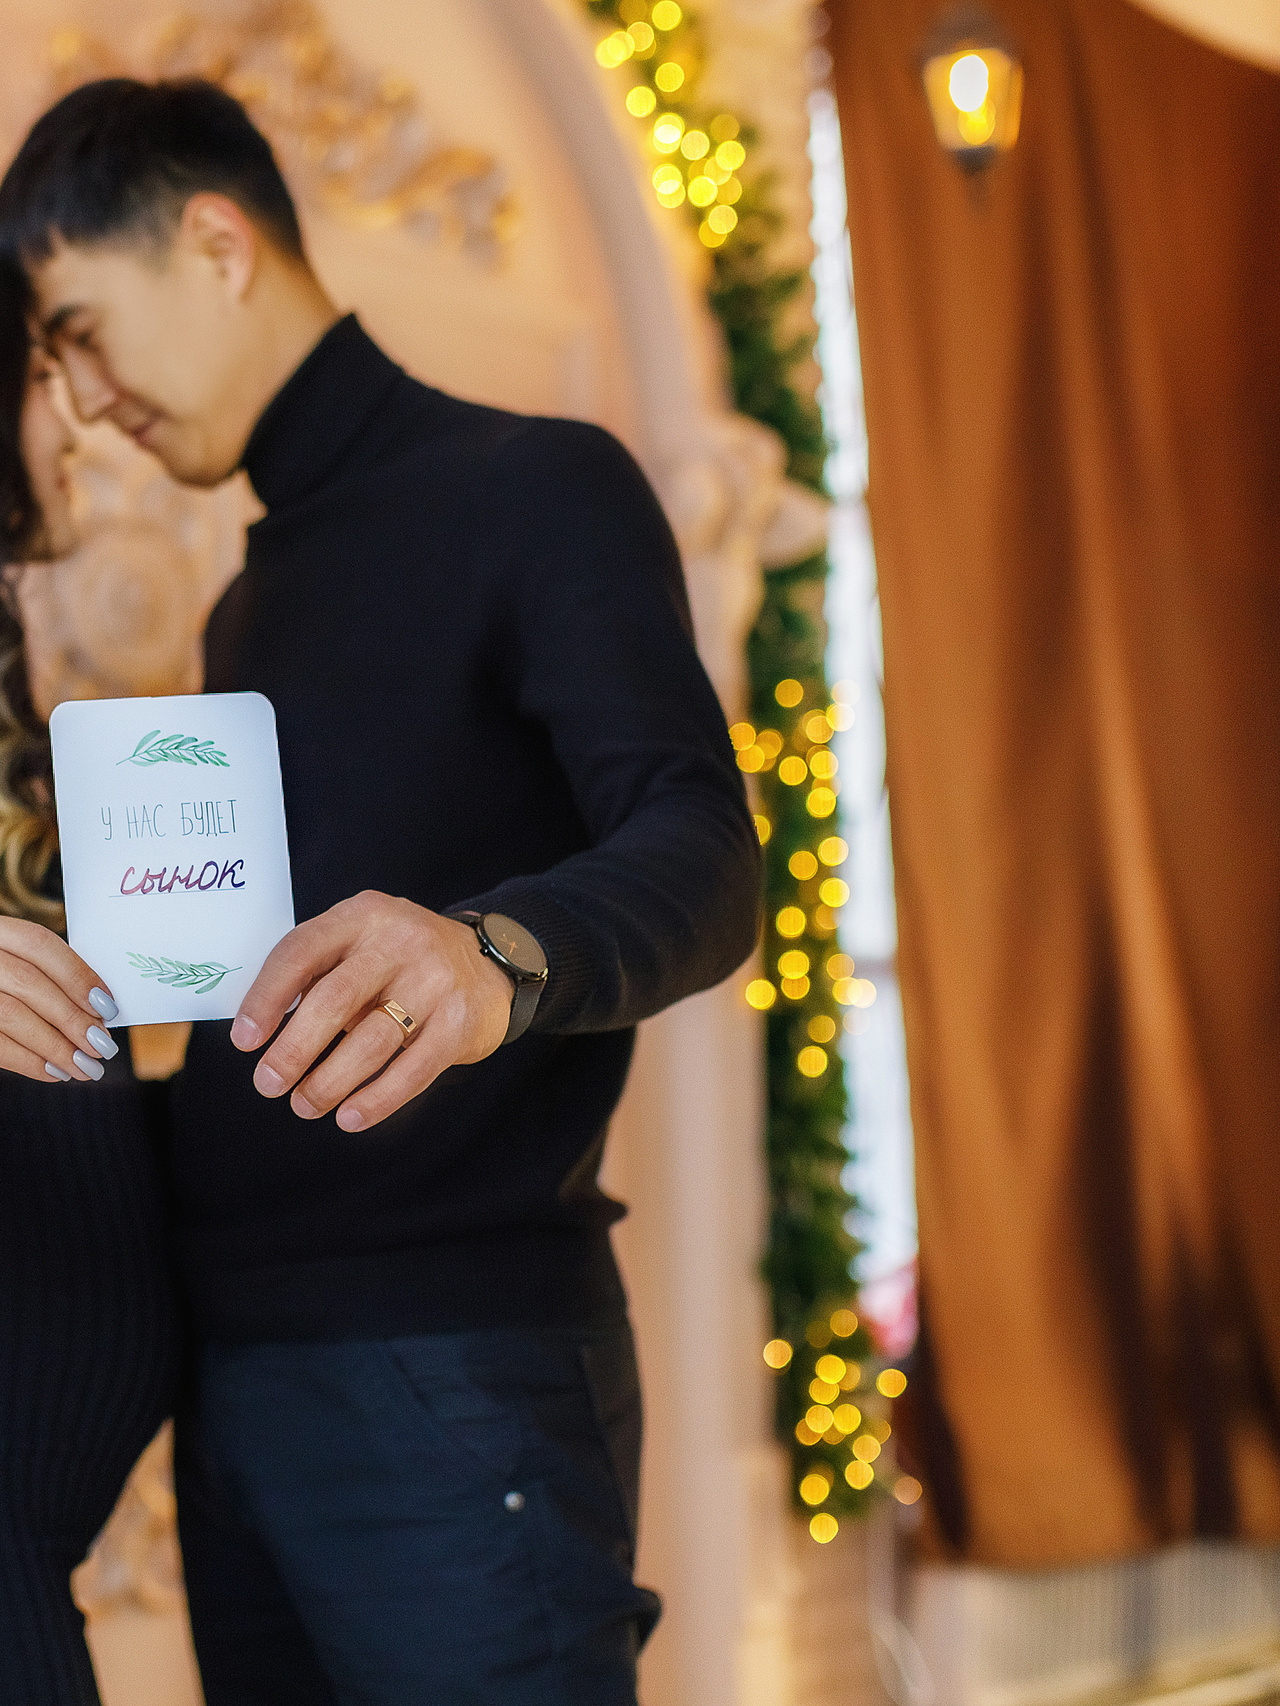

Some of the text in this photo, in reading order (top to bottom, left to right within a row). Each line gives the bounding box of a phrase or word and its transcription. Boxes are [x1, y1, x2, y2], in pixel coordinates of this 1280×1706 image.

[100, 799, 238, 840] У НАС БУДЕТ
